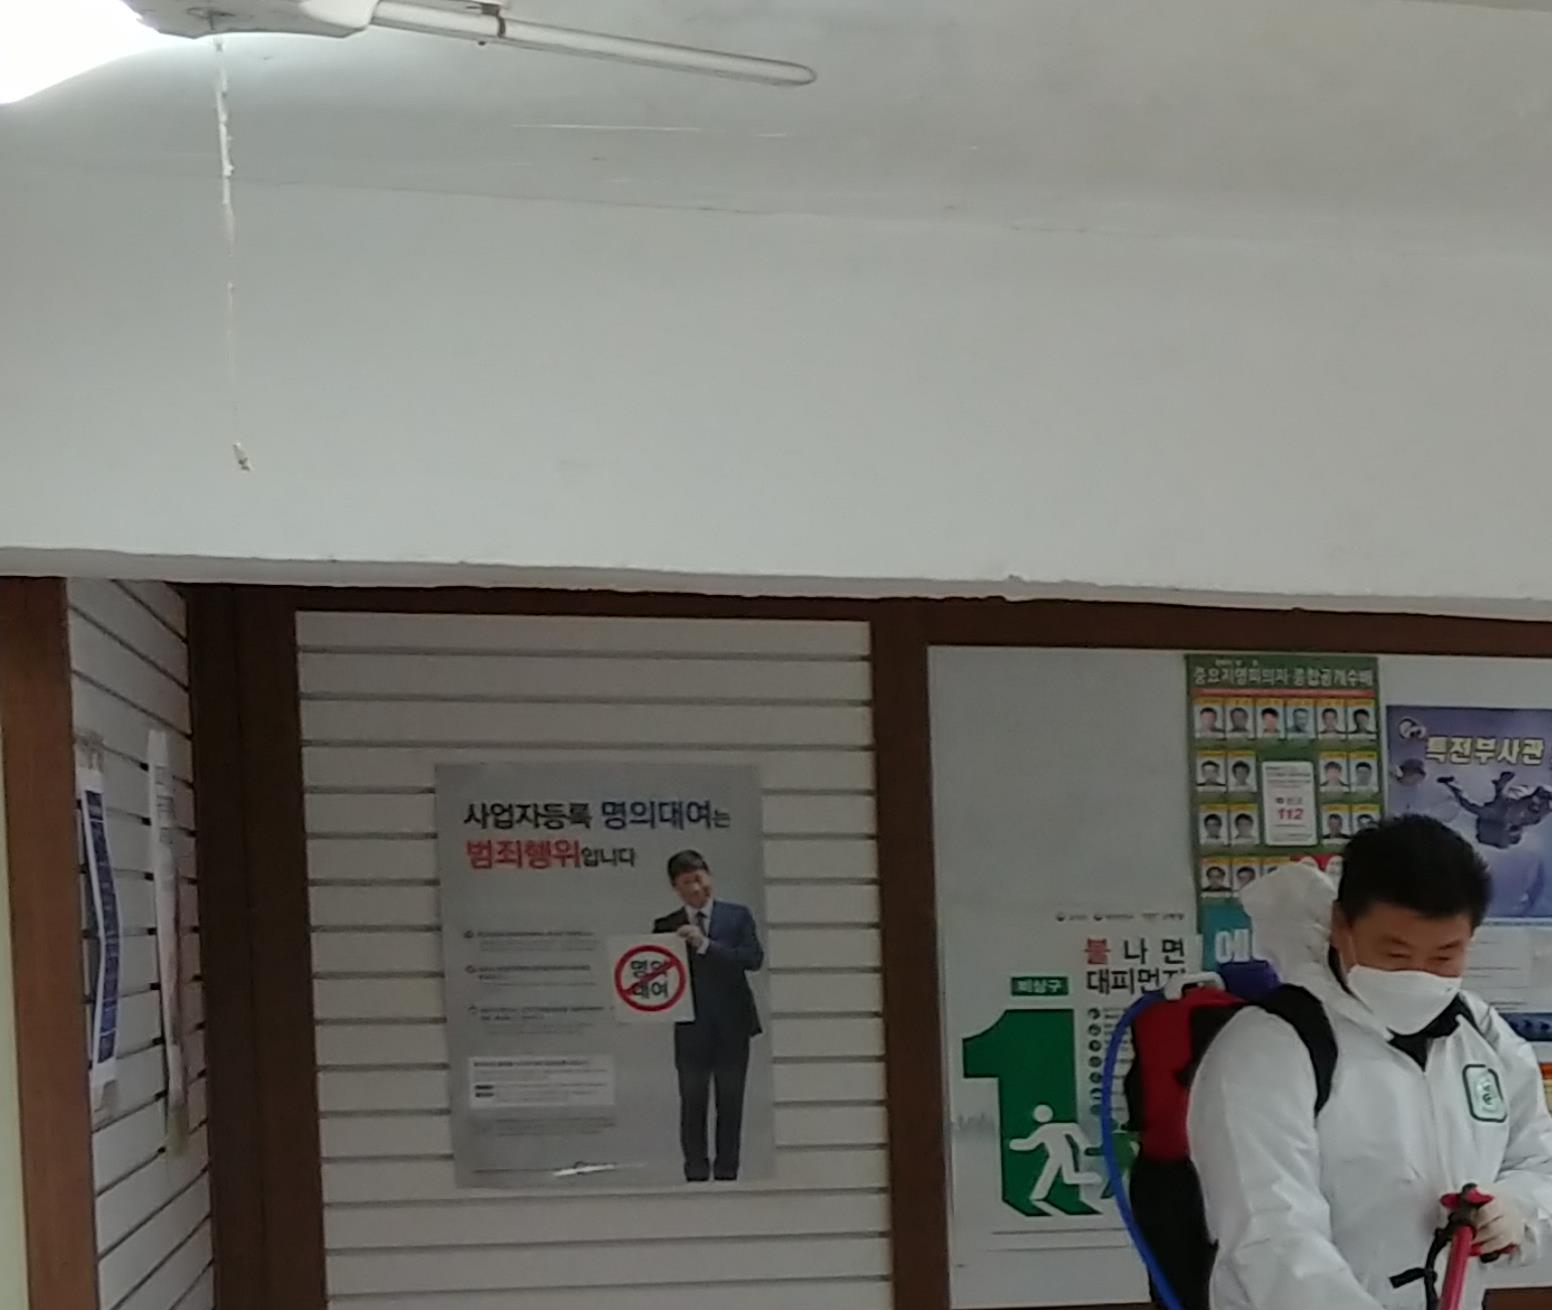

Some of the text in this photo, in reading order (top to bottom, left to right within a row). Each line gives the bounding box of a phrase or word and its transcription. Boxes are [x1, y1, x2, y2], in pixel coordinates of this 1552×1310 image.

[1425, 736, 1544, 765] 특전부사관
[464, 801, 731, 830] 사업자등록 명의대여는
[1277, 808, 1304, 821] 112
[466, 839, 636, 870] 범죄행위입니다
